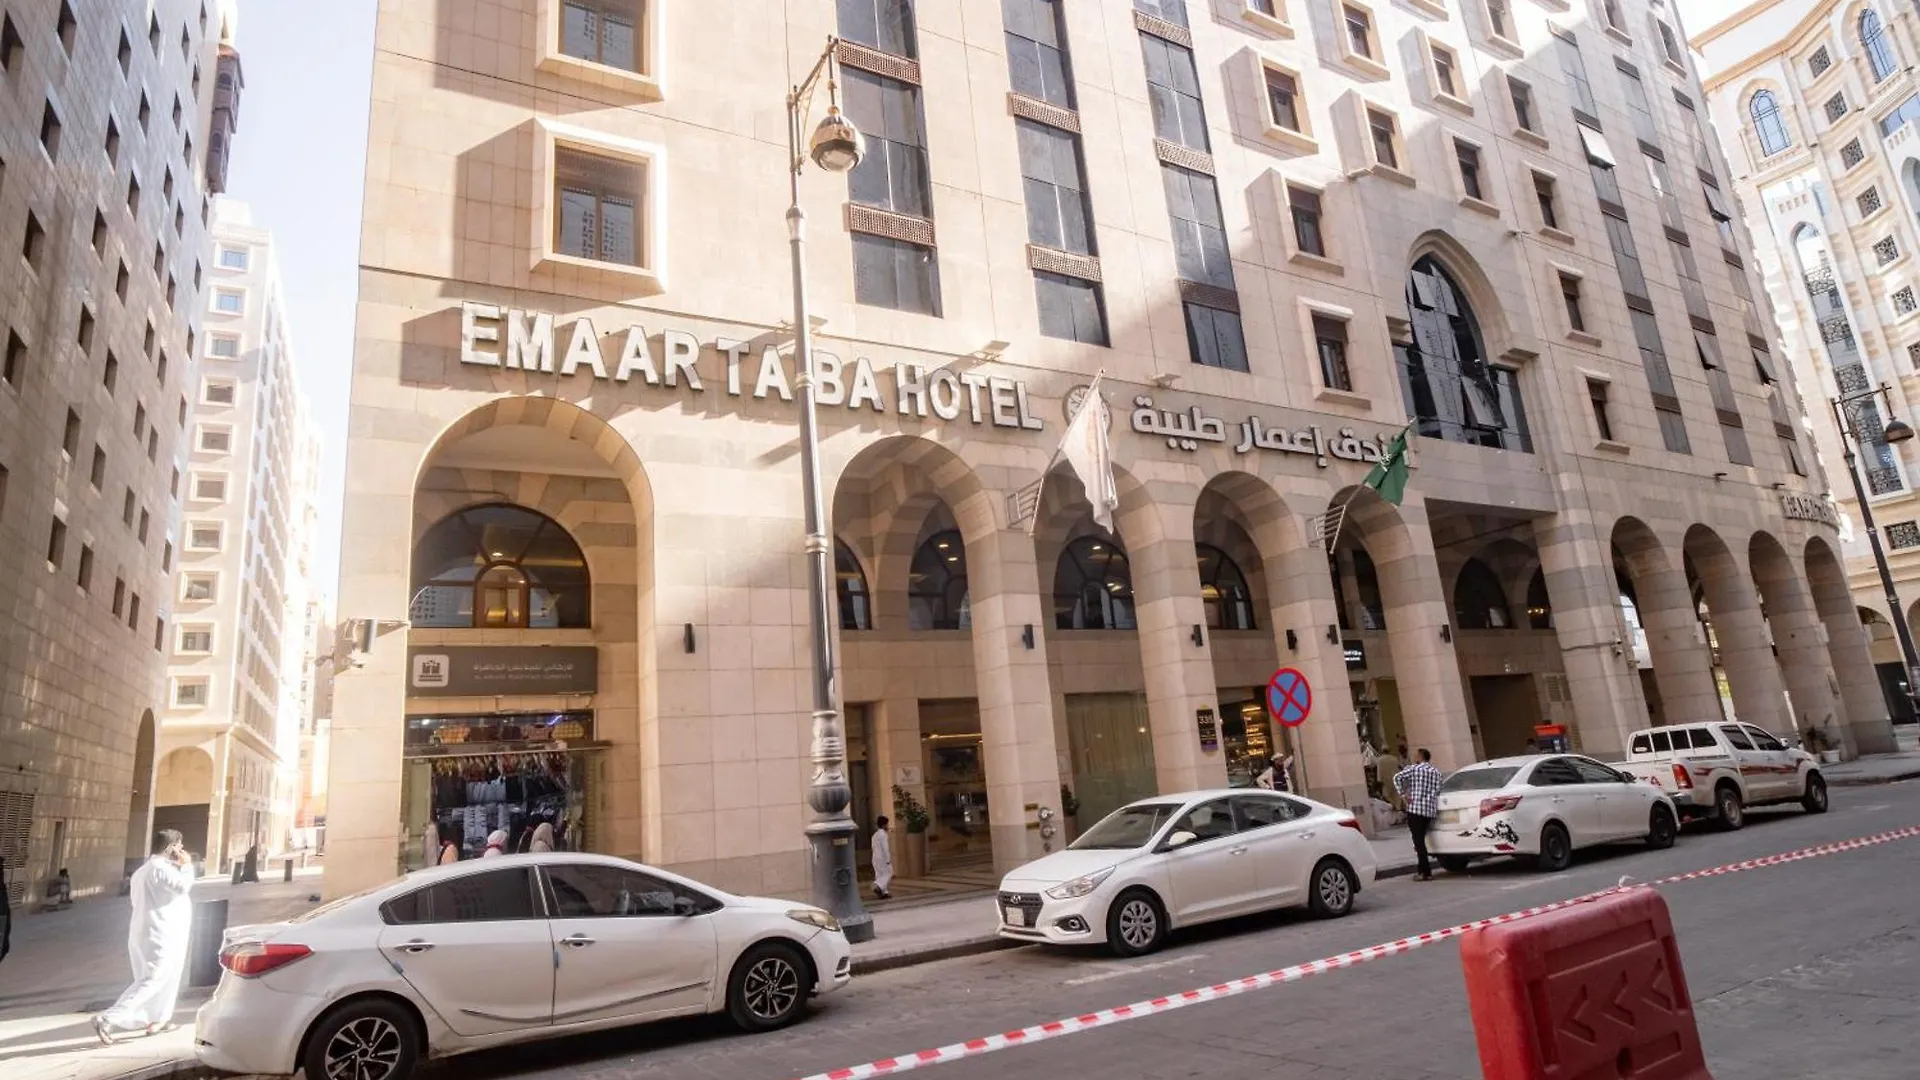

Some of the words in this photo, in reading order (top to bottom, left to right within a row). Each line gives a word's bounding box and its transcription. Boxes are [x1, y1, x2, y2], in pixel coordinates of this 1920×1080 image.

[461, 300, 704, 392] EMAAR
[716, 337, 885, 412] TABA
[895, 361, 1044, 431] HOTEL
[1132, 395, 1226, 452] طيبة
[1234, 416, 1329, 468] إعمار
[1328, 426, 1411, 468] ندق
